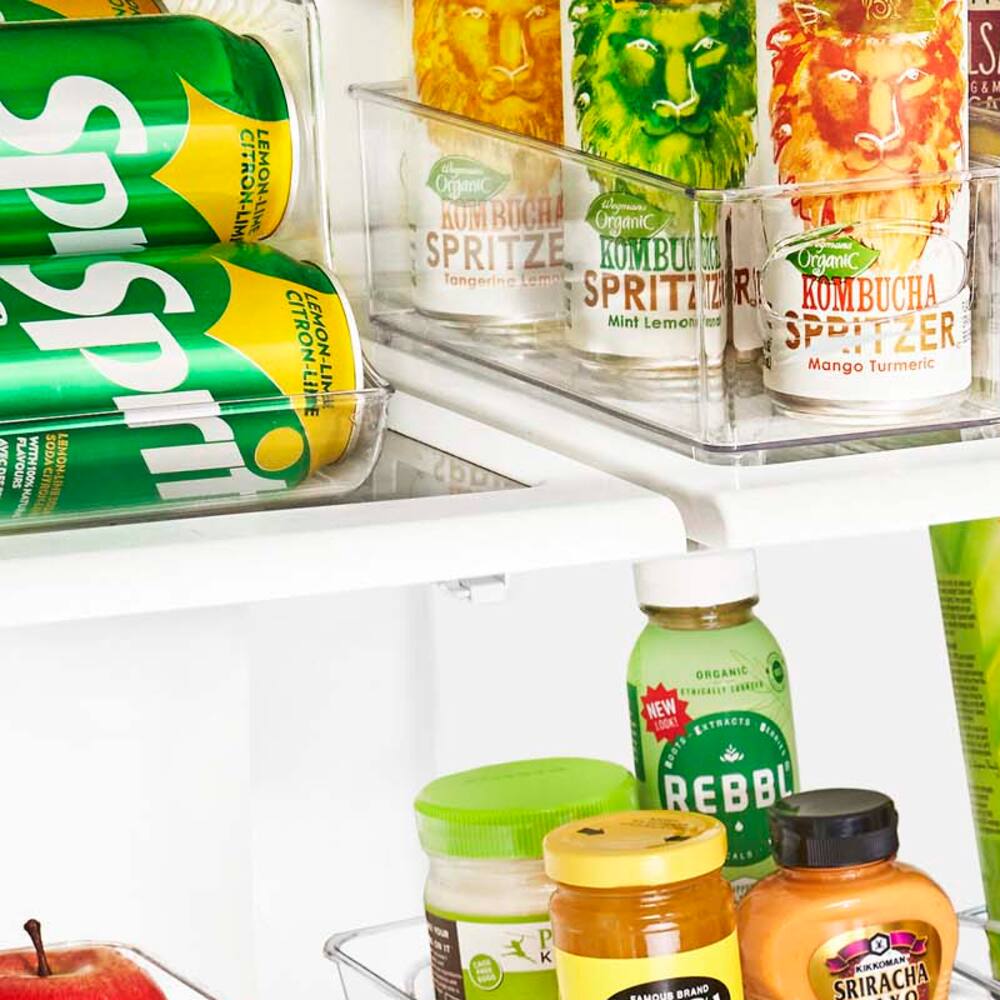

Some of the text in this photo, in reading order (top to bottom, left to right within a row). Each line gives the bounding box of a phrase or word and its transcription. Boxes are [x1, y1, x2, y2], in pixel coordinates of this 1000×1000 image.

[981, 81, 989, 94] &
[595, 211, 655, 237] Organic
[797, 248, 859, 277] Organic
[801, 273, 937, 312] KOMBUCHA
[608, 313, 639, 330] Mint
[785, 310, 955, 354] SPRITZER
[807, 356, 936, 376] Mango Turmeric
[696, 665, 749, 680] ORGANIC
[646, 697, 677, 720] NEW
[693, 717, 751, 736] EXTRACTS
[664, 763, 793, 814] REBBL
[856, 955, 906, 973] KIKKOMAN
[676, 984, 710, 999] BRAND
